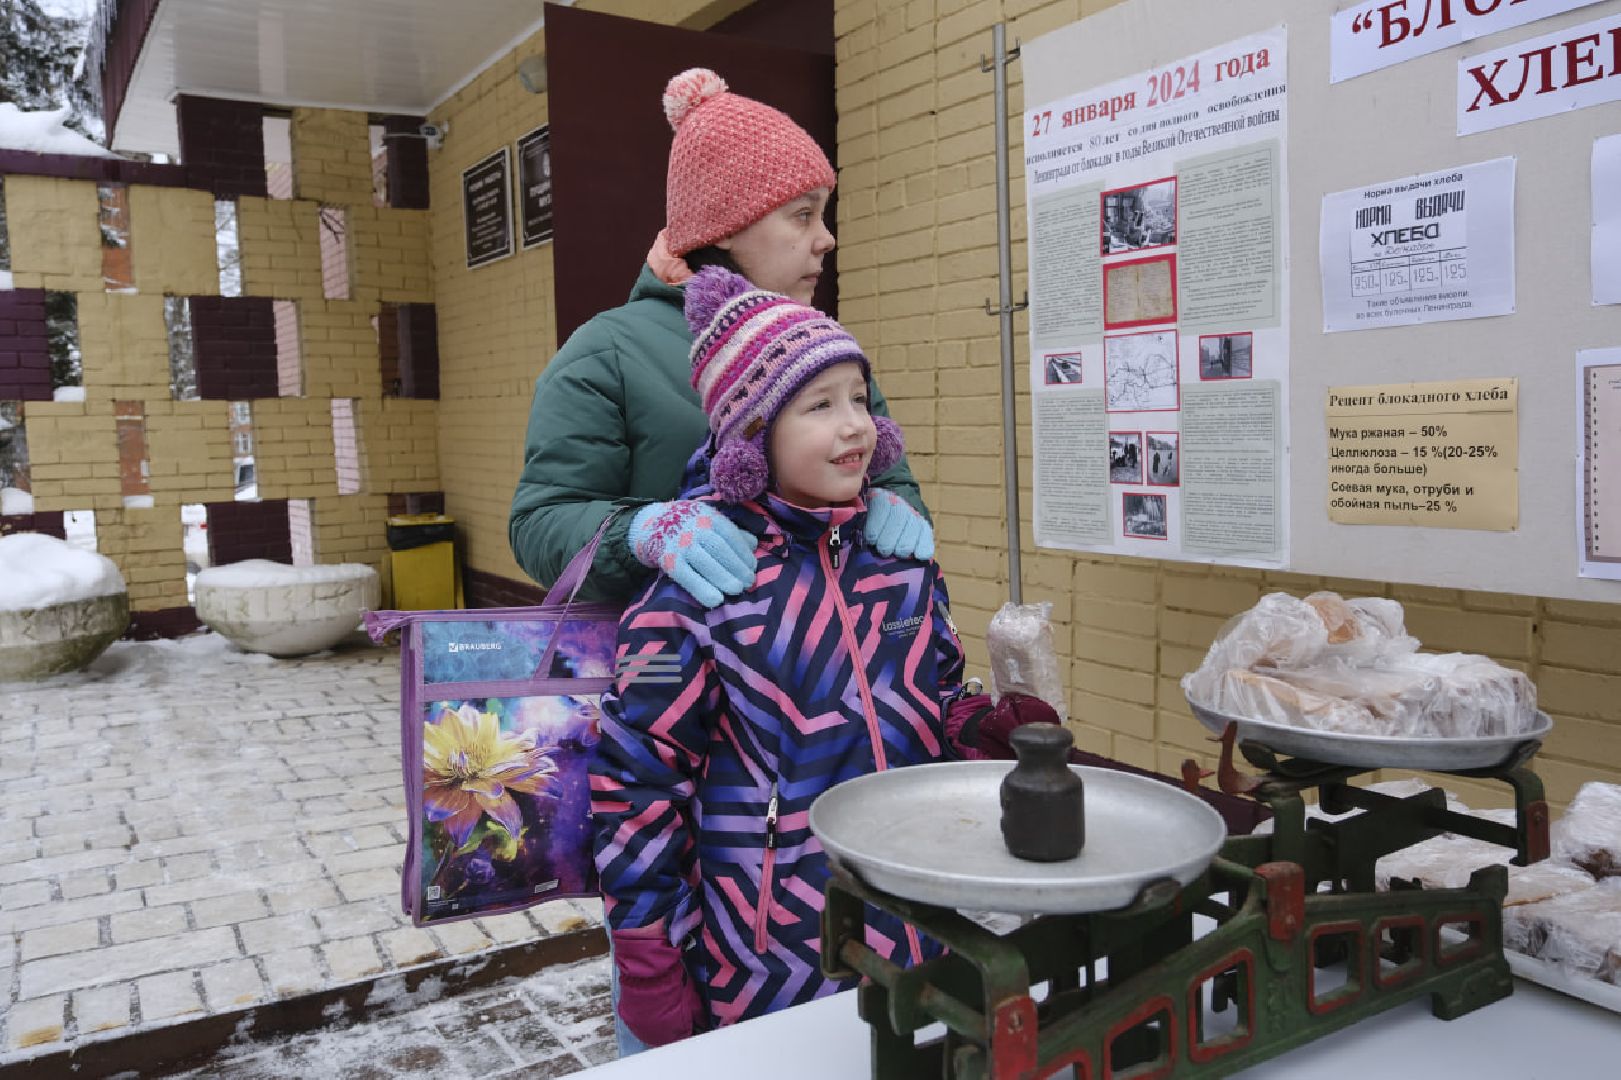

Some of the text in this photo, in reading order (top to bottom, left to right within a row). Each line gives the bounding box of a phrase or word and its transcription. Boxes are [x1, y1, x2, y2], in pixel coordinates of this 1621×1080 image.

[1352, 0, 1528, 48] “БЛ
[1032, 48, 1270, 137] 27 января 2024 года
[1089, 134, 1101, 148] 80
[1103, 133, 1119, 145] лет
[1127, 126, 1138, 137] со
[1139, 120, 1157, 135] дня
[1159, 111, 1199, 128] полного
[1207, 84, 1286, 113] освобождения
[1033, 164, 1071, 184] Ленинграда
[1080, 154, 1112, 171] блокады
[1122, 143, 1141, 160] годы
[1142, 131, 1176, 155] Великой
[1178, 115, 1245, 146] Отечественной
[1247, 108, 1280, 128] войны
[1364, 173, 1463, 199] Норма выдачи хлеба
[1355, 189, 1466, 230] НОРМА ВЫДАЧИ
[1329, 387, 1509, 407] Рецепт блокадного хлеба
[1329, 427, 1358, 440] Мука
[1361, 429, 1405, 440] ржаная
[1421, 425, 1448, 437] 50%
[1331, 446, 1397, 459] Целлюлоза
[1413, 445, 1428, 458] 15
[1331, 463, 1428, 477] иногда больше)
[1331, 481, 1474, 497] Соевая мука, отруби и
[1331, 497, 1380, 509] обойная
[1445, 500, 1458, 512] %
[458, 642, 502, 651] BRAUBERG
